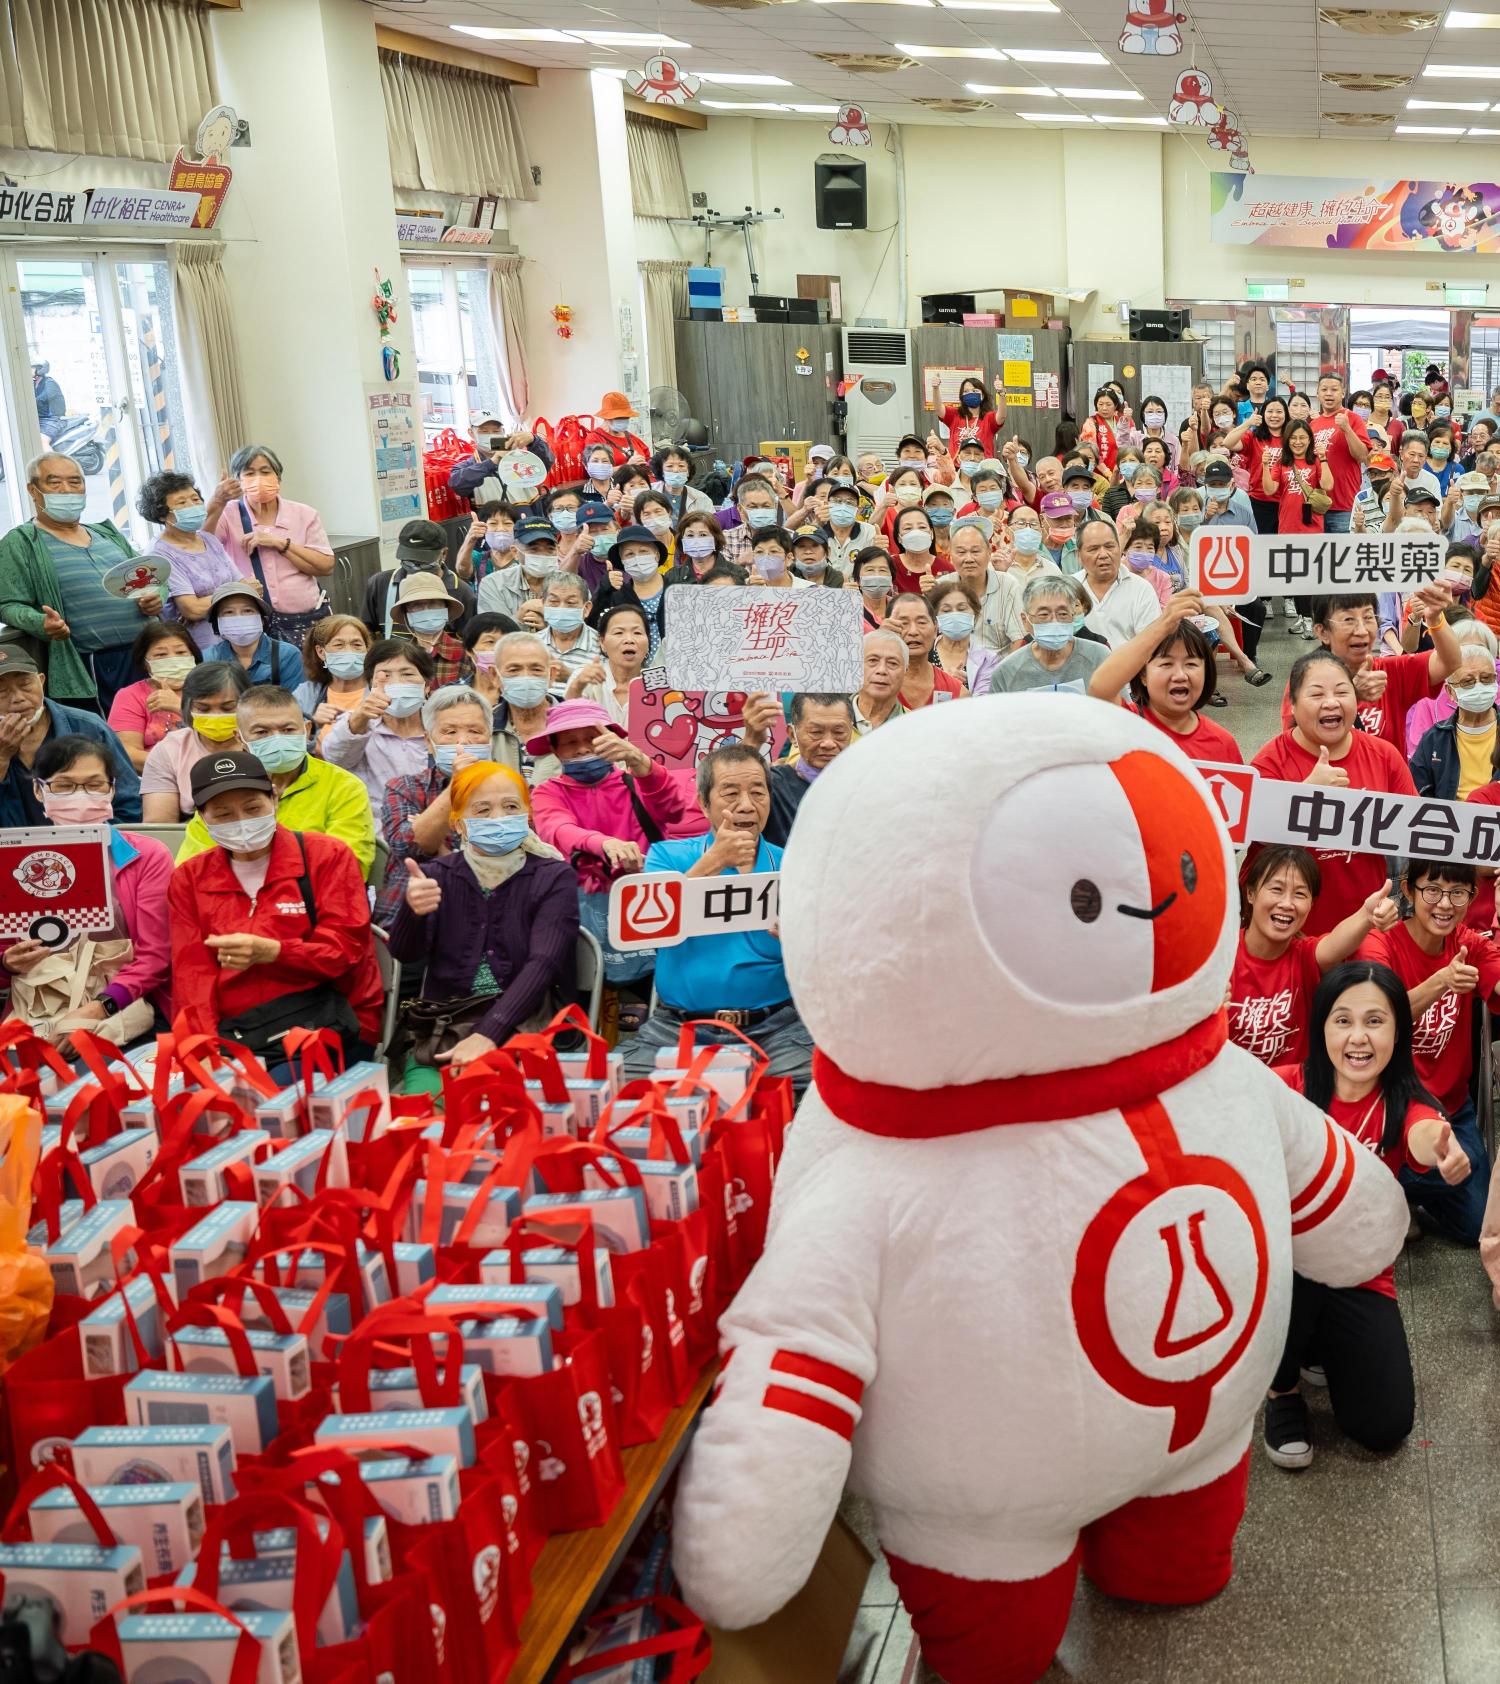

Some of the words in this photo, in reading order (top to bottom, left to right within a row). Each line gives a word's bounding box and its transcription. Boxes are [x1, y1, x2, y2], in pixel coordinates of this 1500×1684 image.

[91, 196, 153, 221] 中化裕民
[150, 212, 191, 224] Healthcare
[1268, 541, 1441, 584] 中化製藥
[732, 601, 798, 629] 擁抱
[741, 625, 800, 661] 生命
[642, 666, 670, 692] 愛
[31, 852, 73, 870] EMBRACE
[1230, 988, 1294, 1030] 擁抱
